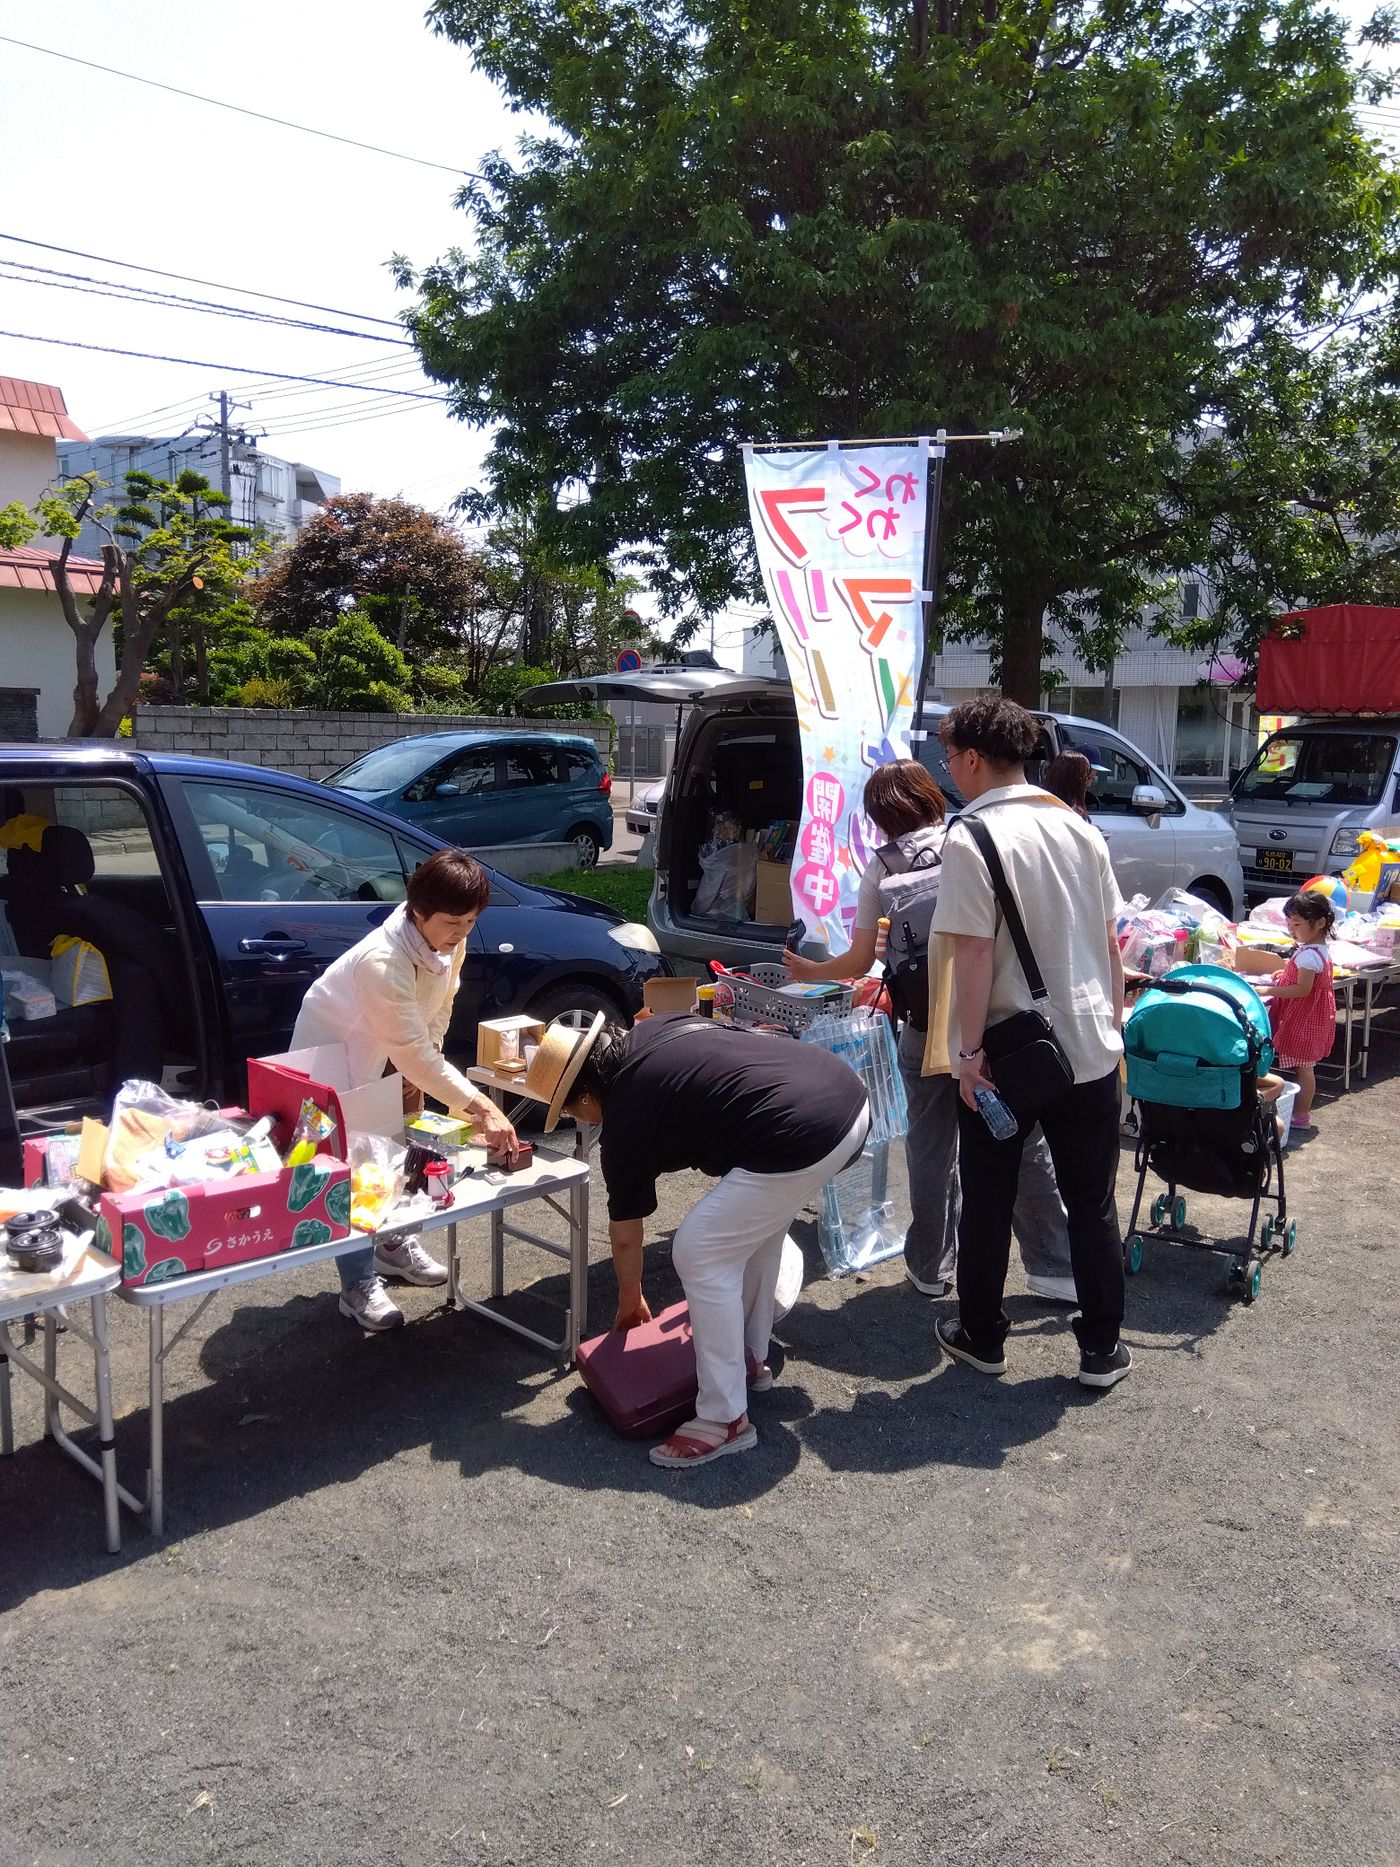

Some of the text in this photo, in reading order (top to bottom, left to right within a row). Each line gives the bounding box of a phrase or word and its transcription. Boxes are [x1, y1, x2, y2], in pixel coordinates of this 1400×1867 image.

[1263, 857, 1291, 870] 90-02
[226, 1228, 274, 1249] さかうえ
